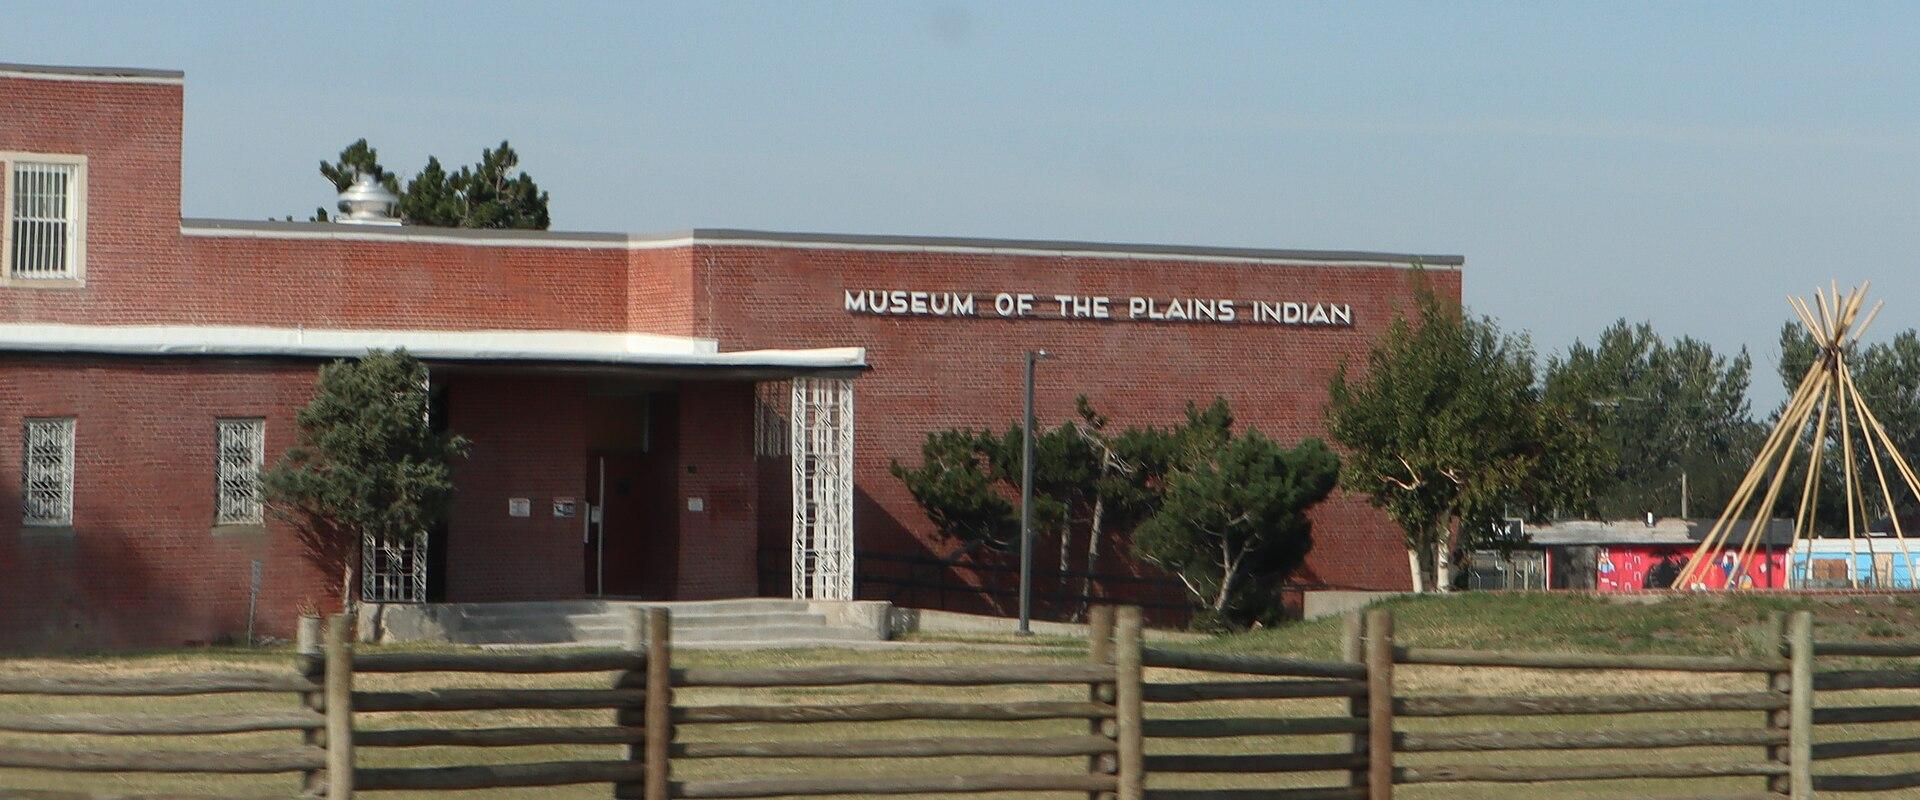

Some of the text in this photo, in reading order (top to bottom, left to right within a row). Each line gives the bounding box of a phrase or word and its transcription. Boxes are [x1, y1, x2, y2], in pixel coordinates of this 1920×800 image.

[844, 289, 1352, 325] MUSEUM OF THE PLAINS INDIAN
